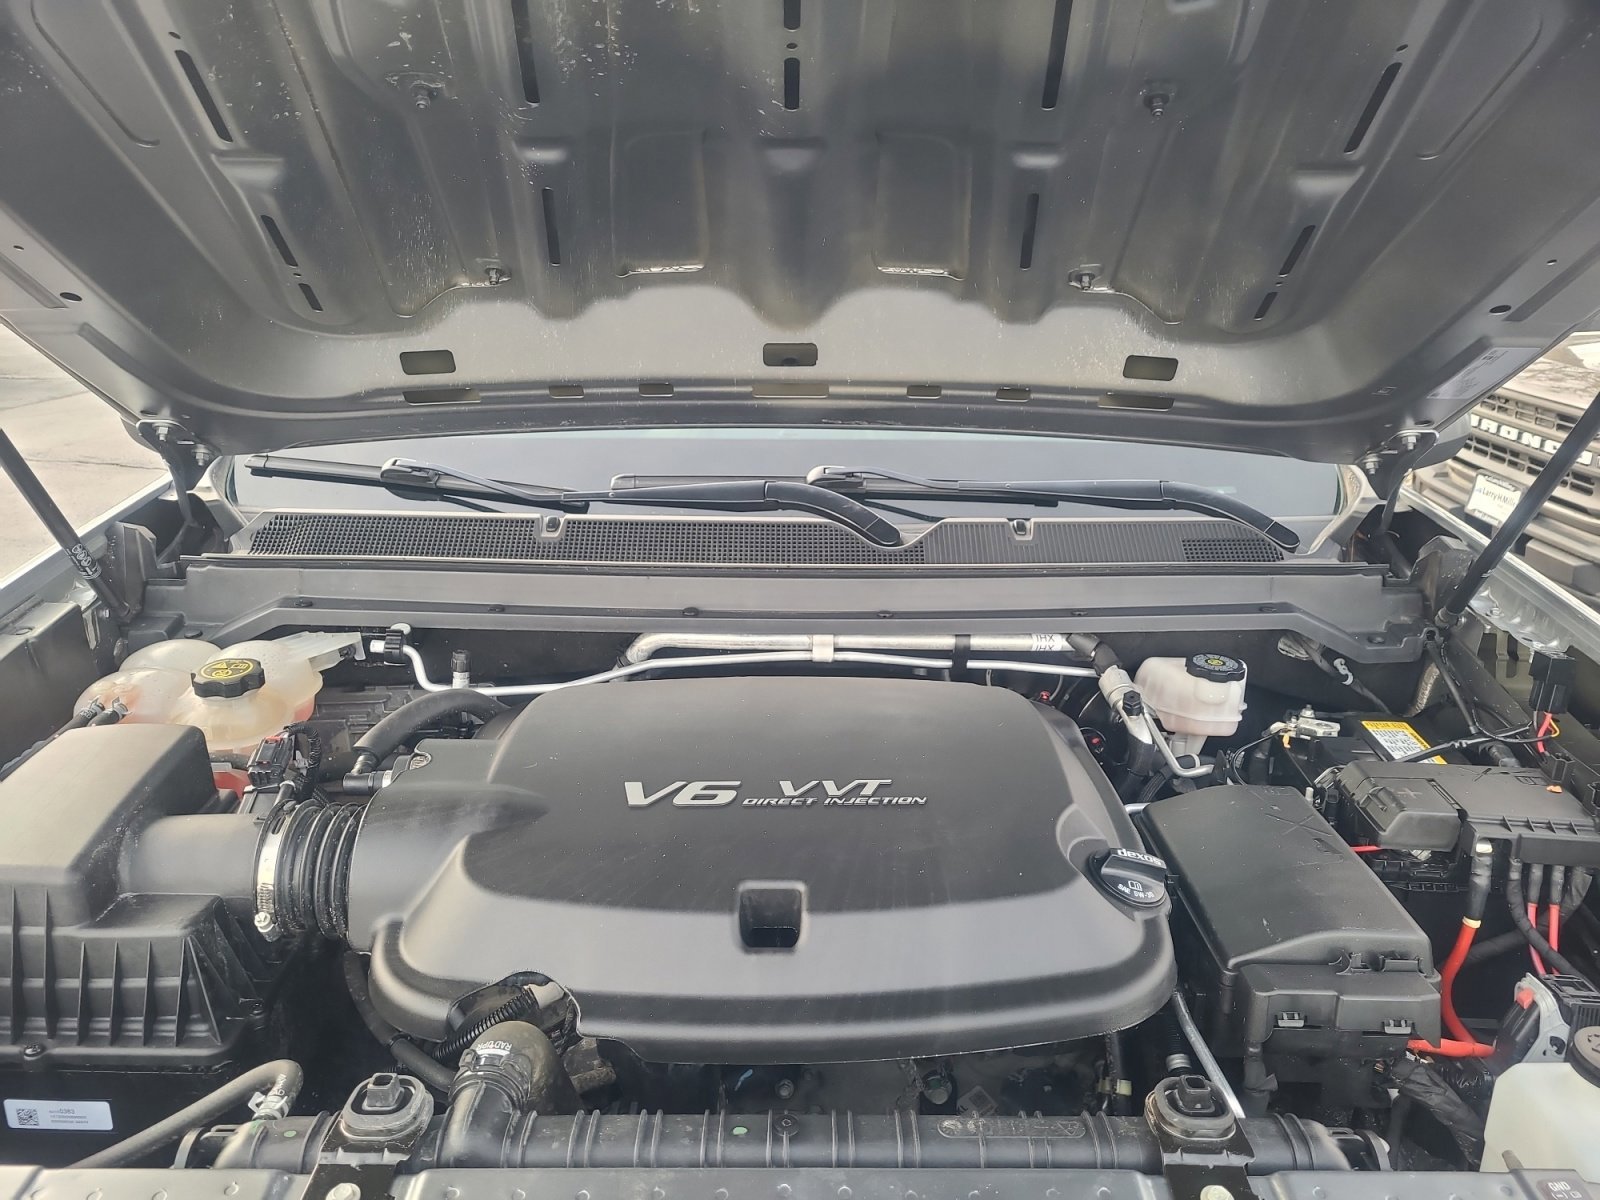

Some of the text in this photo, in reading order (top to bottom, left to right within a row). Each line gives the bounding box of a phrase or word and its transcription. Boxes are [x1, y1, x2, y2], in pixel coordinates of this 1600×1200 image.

[624, 781, 741, 806] V6
[779, 779, 892, 797] VVT
[742, 796, 927, 806] DIRECT INJECTION
[1117, 848, 1162, 866] dexos
